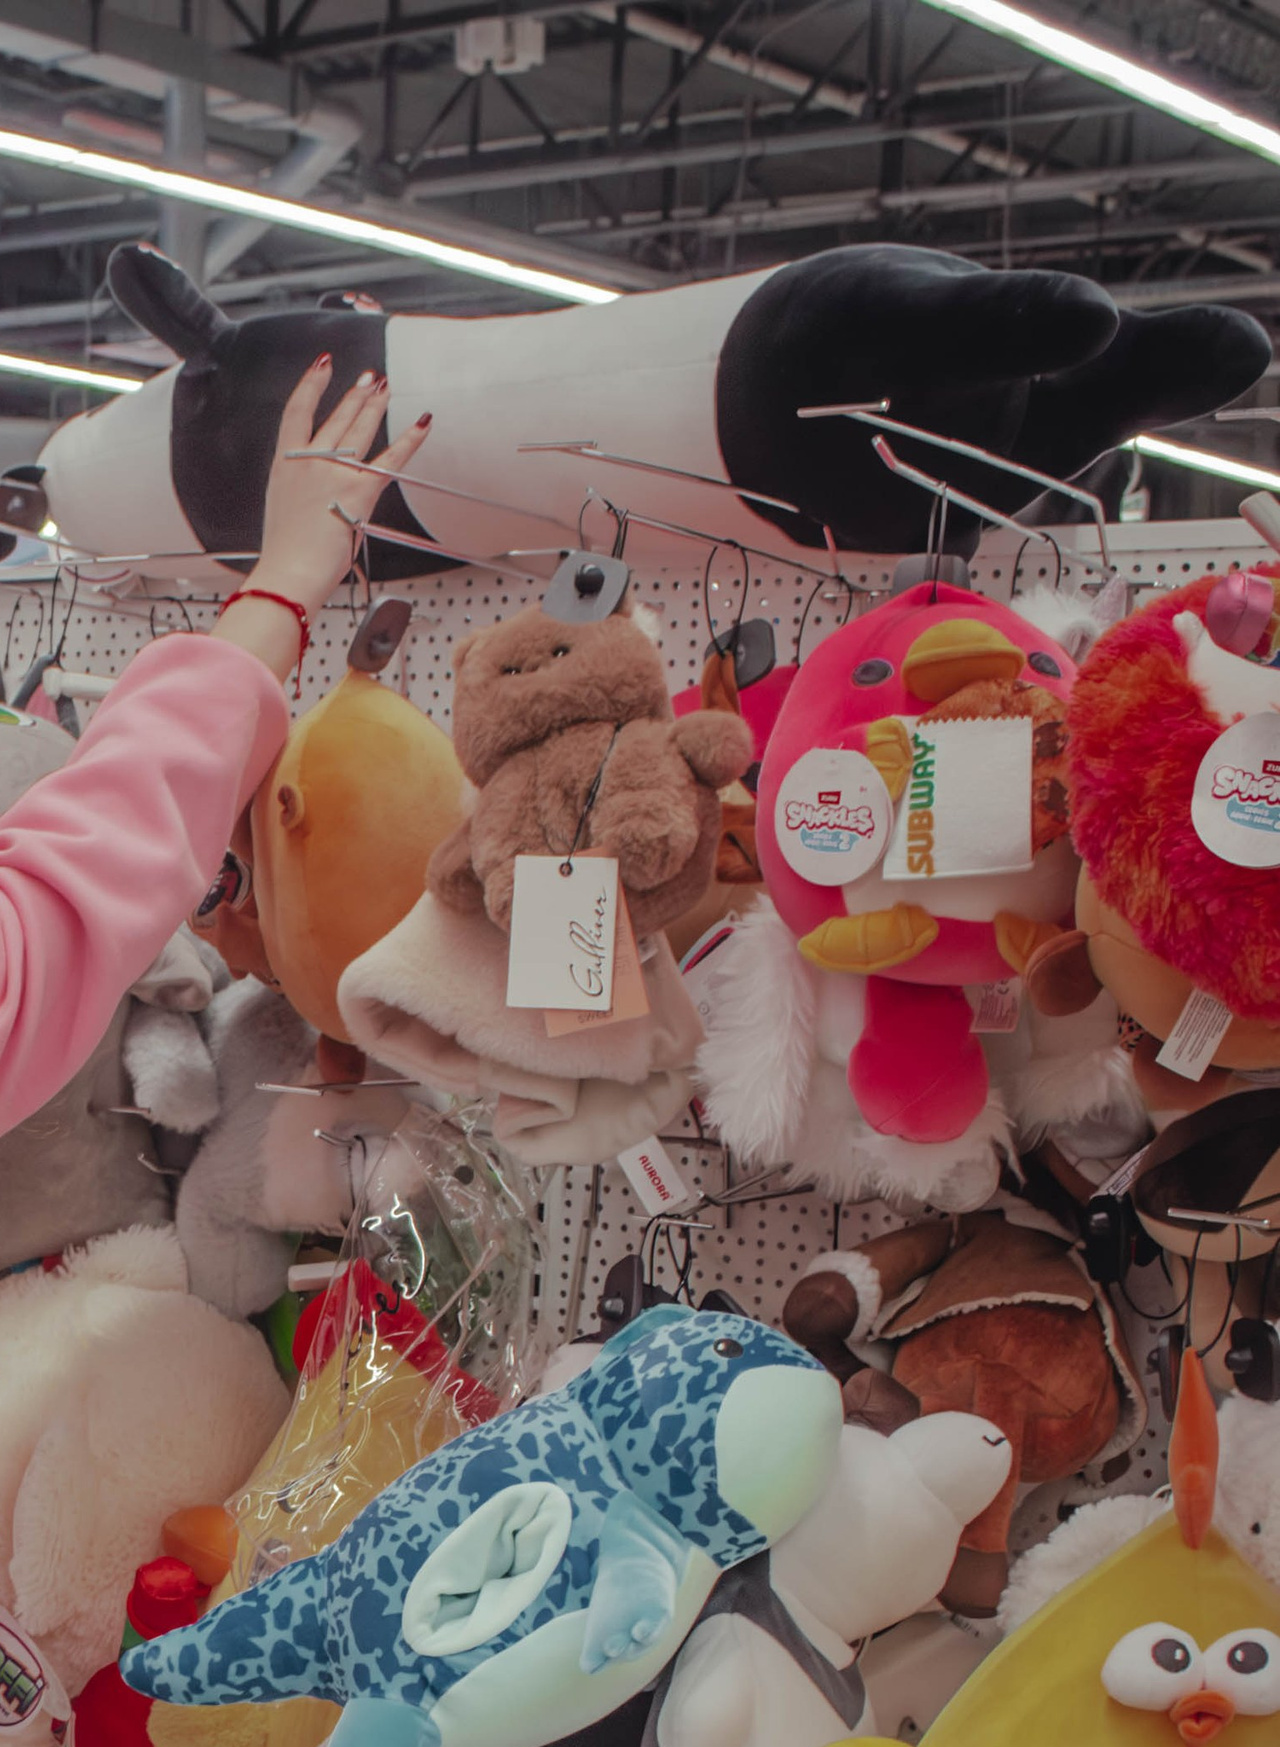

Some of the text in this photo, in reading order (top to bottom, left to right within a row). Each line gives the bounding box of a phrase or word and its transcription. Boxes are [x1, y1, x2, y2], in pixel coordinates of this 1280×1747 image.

[785, 800, 875, 836] SNACKLES
[907, 732, 936, 878] SUBWAY
[569, 885, 607, 997] Gulliver
[639, 1155, 671, 1201] AURORA
